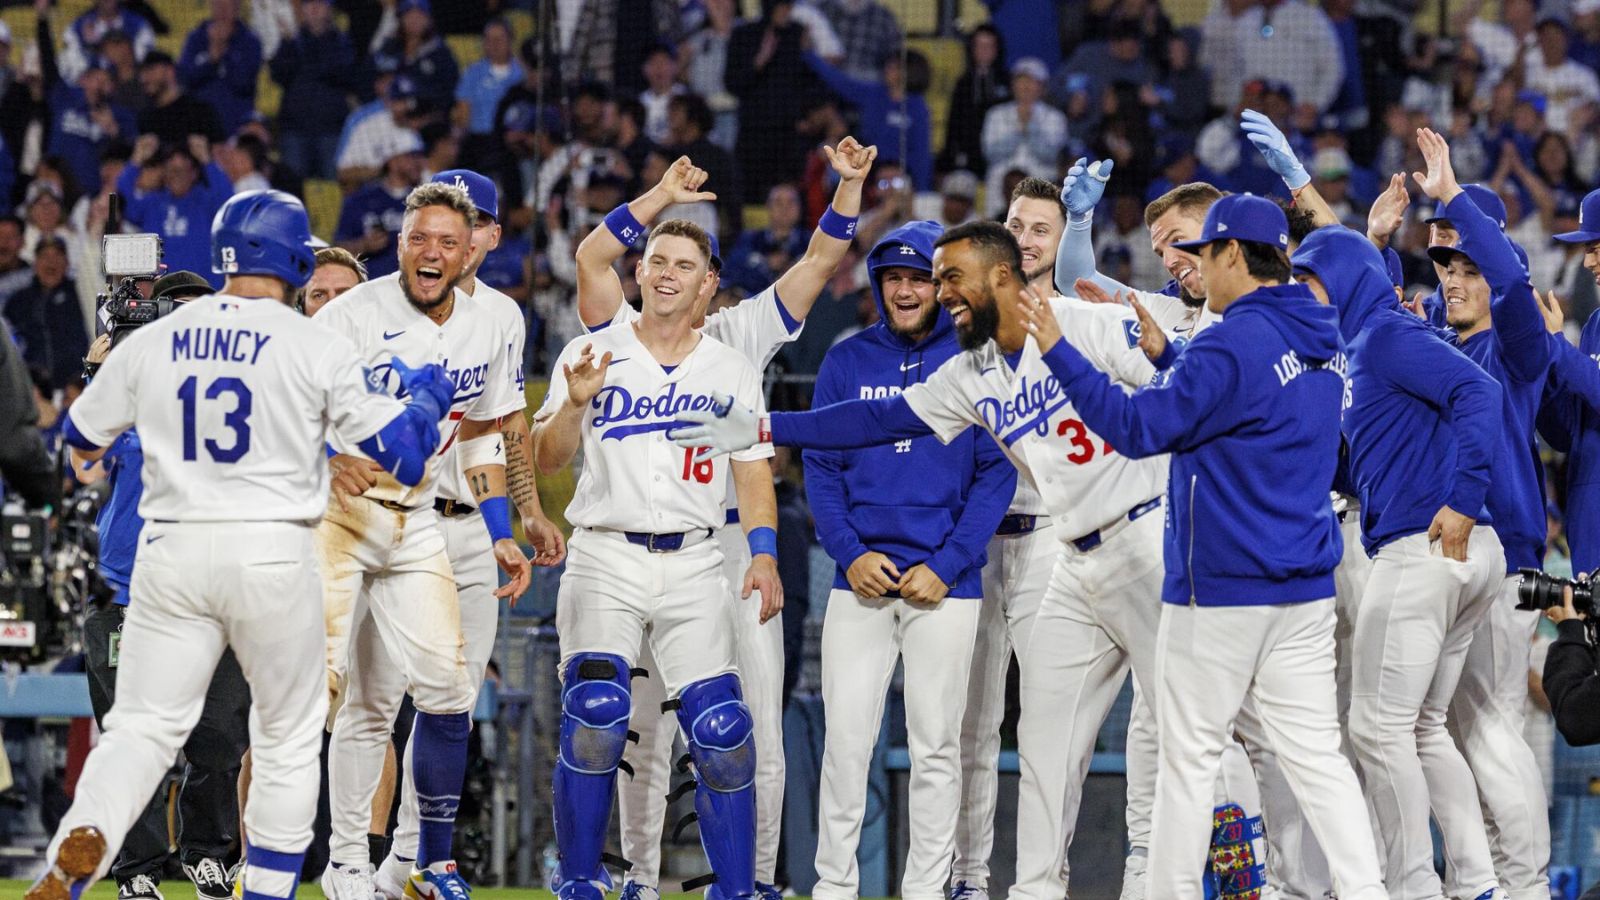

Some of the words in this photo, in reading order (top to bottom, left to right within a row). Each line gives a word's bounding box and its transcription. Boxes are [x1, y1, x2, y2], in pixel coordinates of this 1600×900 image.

[221, 246, 236, 262] 13
[172, 327, 271, 365] MUNCY
[1273, 349, 1302, 387] LOS
[177, 375, 252, 464] 13
[587, 382, 722, 440] Dodger
[974, 374, 1061, 437] Dodge
[1056, 418, 1115, 465] 3
